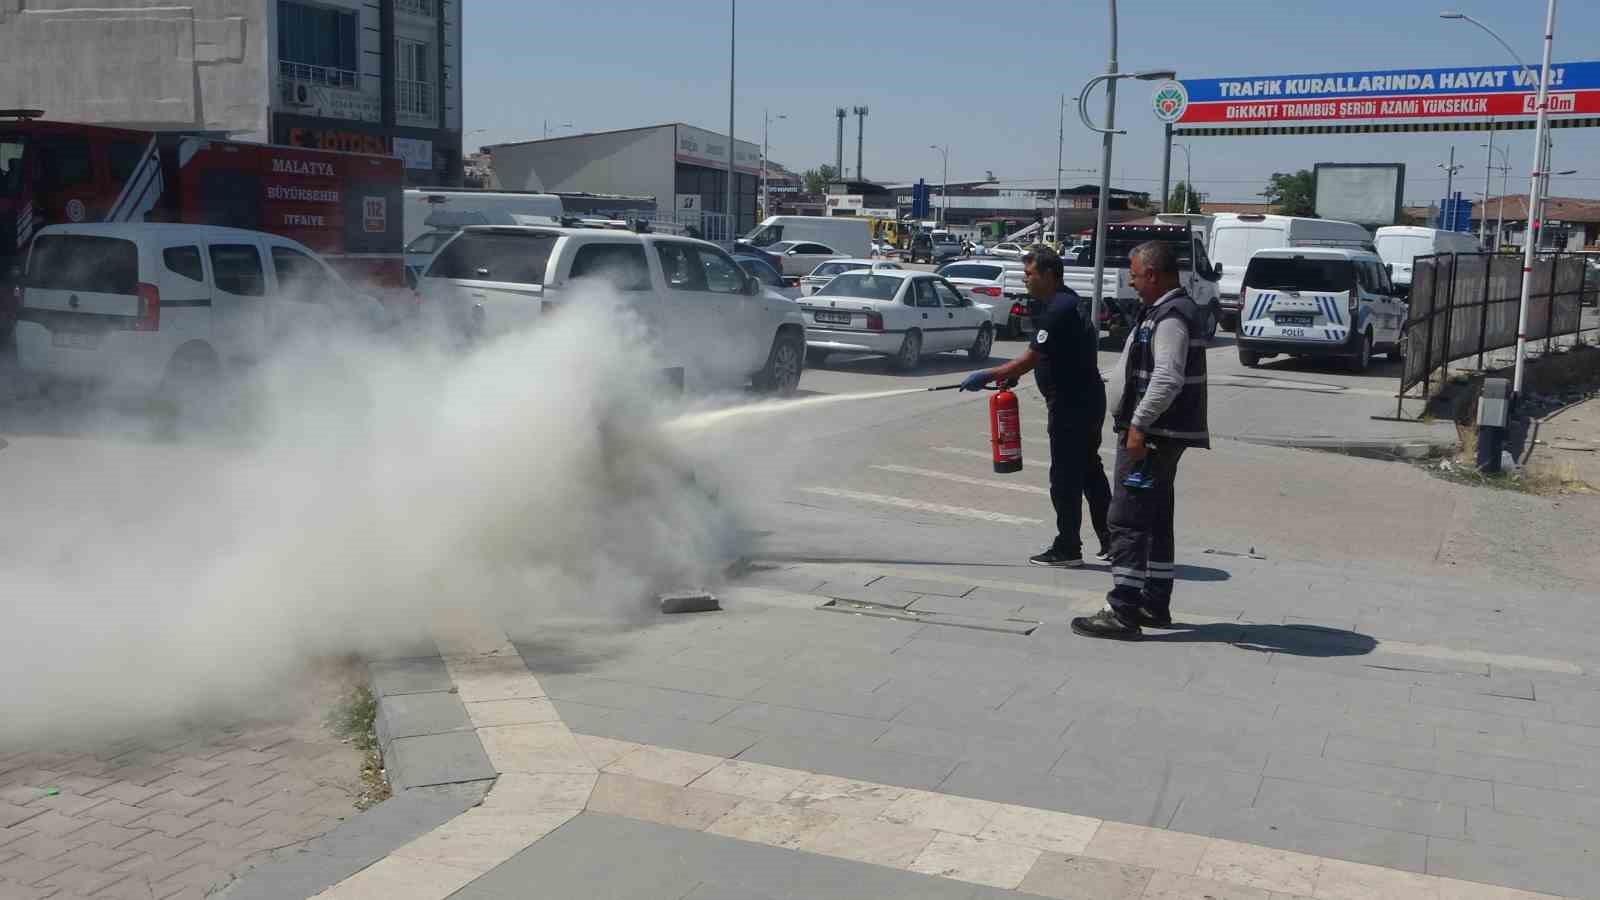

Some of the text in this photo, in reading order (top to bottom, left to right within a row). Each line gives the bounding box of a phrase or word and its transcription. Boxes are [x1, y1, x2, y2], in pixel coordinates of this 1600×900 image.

[1219, 68, 1566, 97] TRAFİK KURALLARINDA HAYAT VAR!
[1226, 104, 1278, 118] DİKKAT!
[1380, 99, 1419, 115] AZAMİ
[1423, 98, 1488, 113] YÜKSEKLİK
[272, 159, 336, 176] MALATYA
[367, 200, 384, 217] 112
